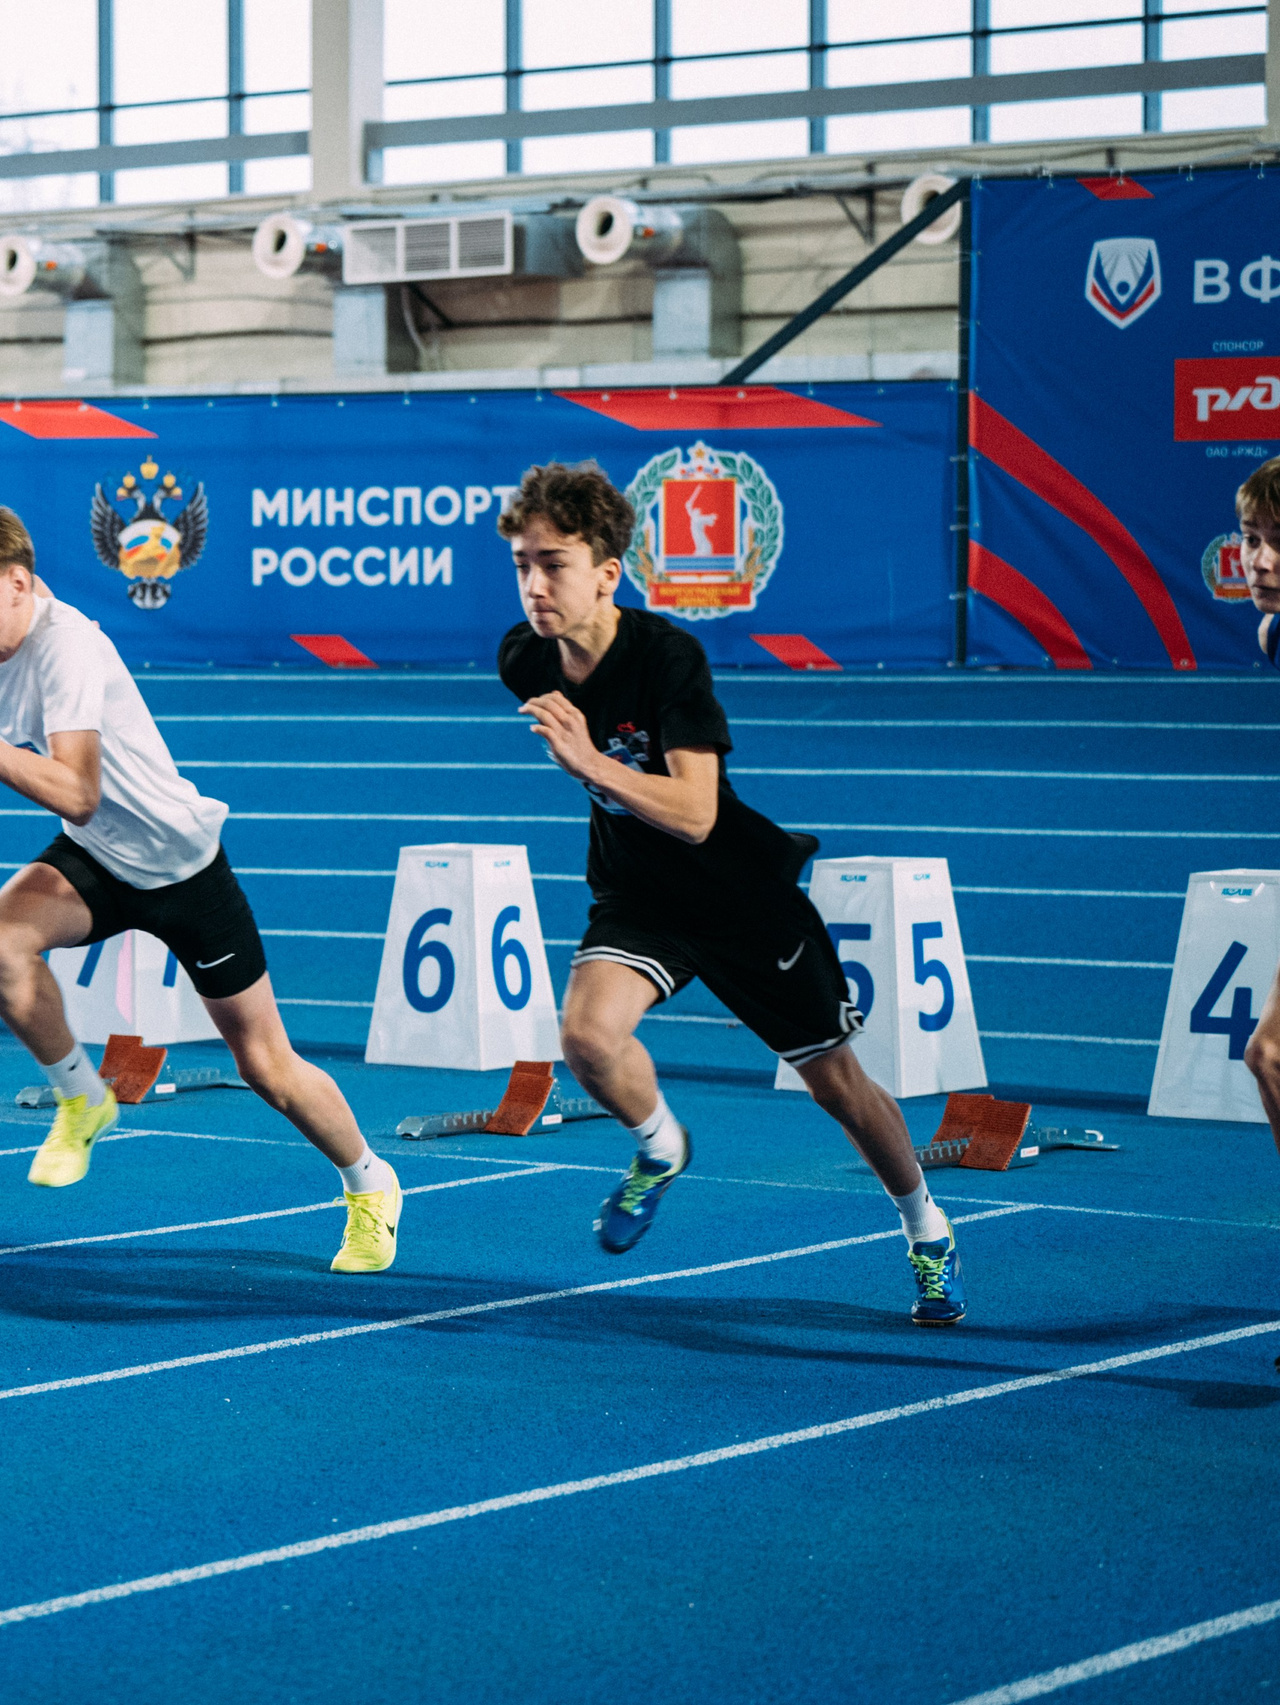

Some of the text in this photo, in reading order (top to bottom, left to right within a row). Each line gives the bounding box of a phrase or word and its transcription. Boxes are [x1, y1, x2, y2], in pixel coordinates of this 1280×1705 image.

[1212, 340, 1265, 353] СПОНСОР
[253, 547, 452, 586] РОССИИ
[402, 907, 456, 1014] 6
[491, 905, 532, 1011] 6
[911, 921, 955, 1033] 5
[1189, 940, 1260, 1061] 4
